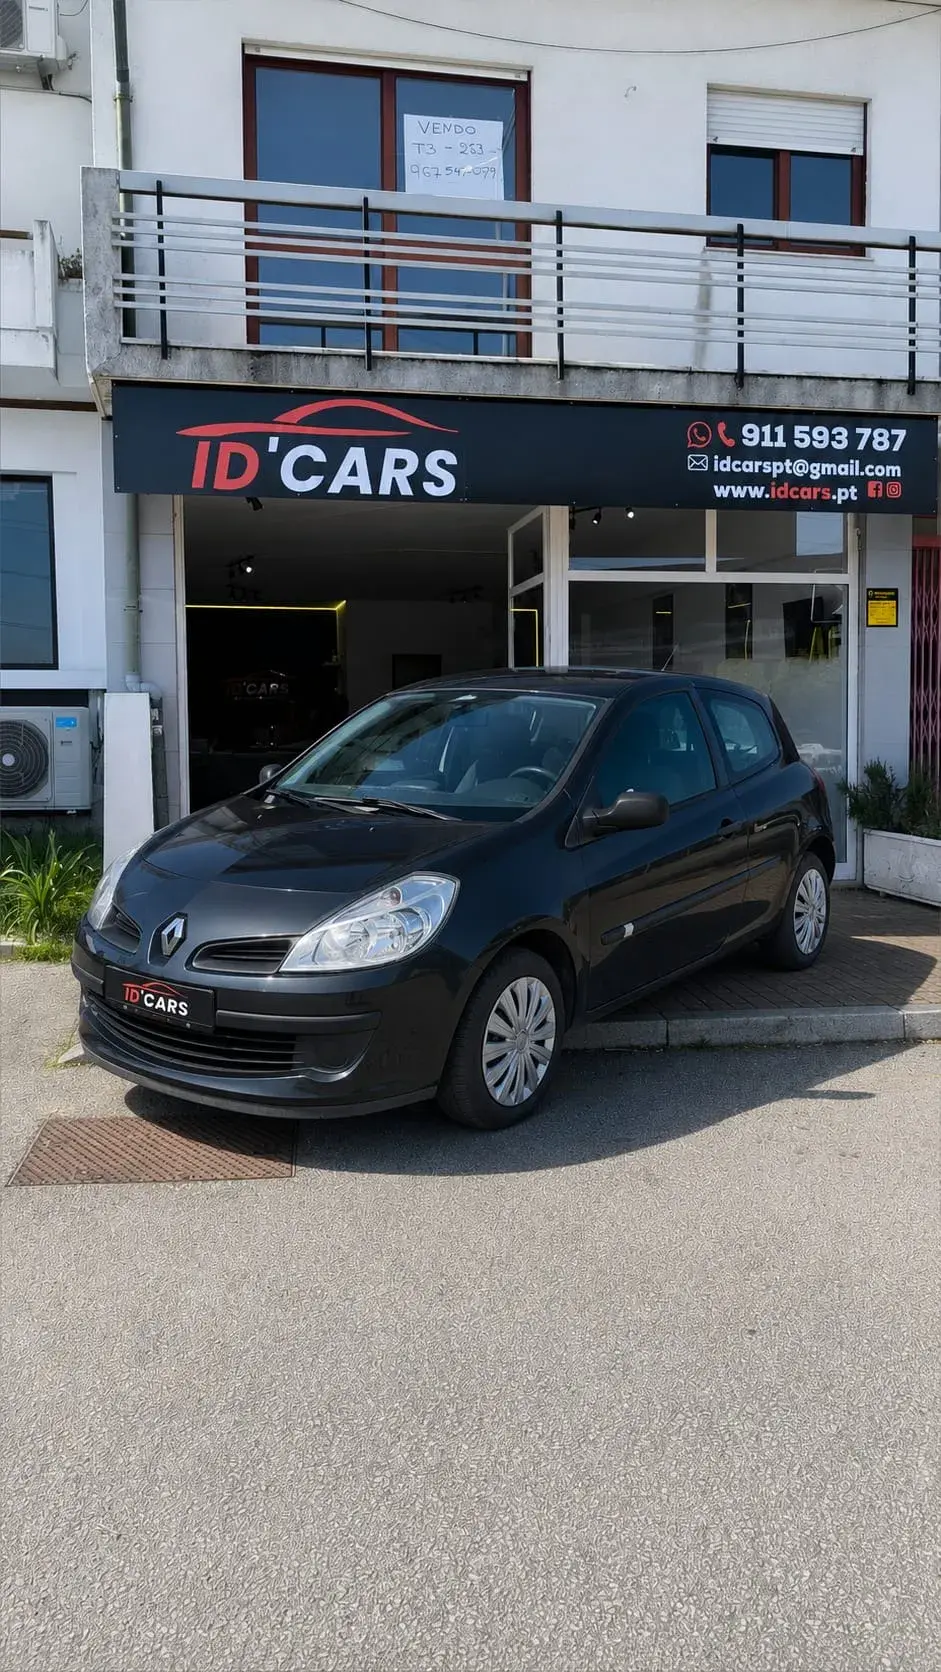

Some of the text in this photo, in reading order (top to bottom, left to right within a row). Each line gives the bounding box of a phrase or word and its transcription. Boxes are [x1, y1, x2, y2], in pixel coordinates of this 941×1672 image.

[417, 120, 477, 135] VENDO
[411, 142, 437, 155] T3
[741, 423, 907, 452] 911 593 787
[191, 436, 458, 497] ID'CARS
[713, 455, 901, 480] idcarspt@gmail.com
[713, 481, 858, 504] www.idcars.pt
[124, 987, 188, 1016] ID'CARS
